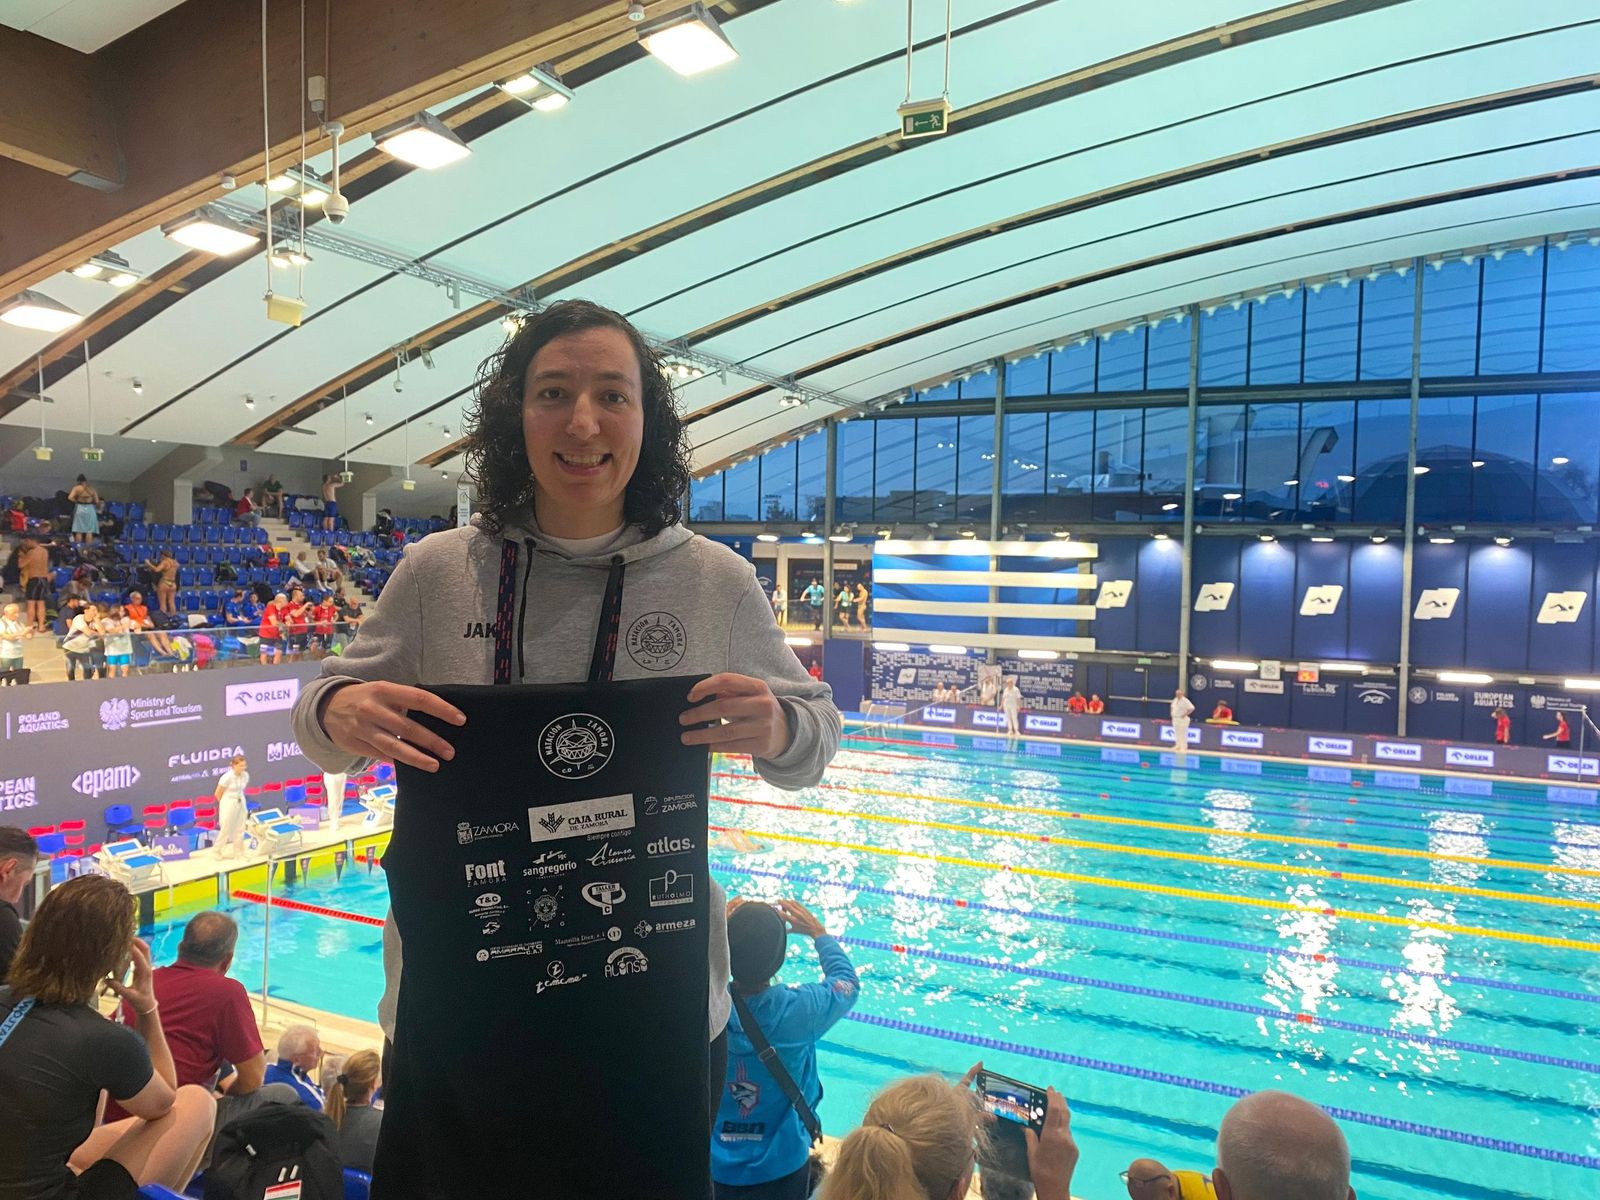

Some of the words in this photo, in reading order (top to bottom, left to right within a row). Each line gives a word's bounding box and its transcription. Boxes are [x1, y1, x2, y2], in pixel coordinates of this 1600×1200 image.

[463, 622, 497, 638] JAK
[130, 697, 164, 708] Ministry
[165, 695, 176, 705] of
[256, 688, 291, 702] ORLEN
[18, 711, 60, 724] POLAND
[130, 707, 153, 720] Sport
[154, 705, 171, 716] and
[172, 703, 202, 715] Tourism
[18, 719, 69, 733] AQUATICS
[1039, 719, 1058, 727] ORLEN
[545, 724, 563, 756] NATACIÓN
[587, 720, 609, 747] ZAMORA
[168, 745, 245, 768] FLUIDRA
[283, 742, 303, 757] Ma
[1393, 748, 1416, 756] ORLEN
[1464, 753, 1489, 761] ORLEN
[661, 801, 698, 813] ZAMORA
[568, 815, 592, 825] CAJA
[594, 809, 628, 822] RURAL
[473, 822, 519, 837] ZAMORA
[580, 820, 608, 829] ZAMORA
[465, 859, 506, 881] Font
[522, 861, 577, 877] sangregorio
[467, 877, 507, 888] ZAMORA
[479, 896, 498, 904] T&C
[655, 919, 696, 931] armeza
[604, 959, 648, 978] ALONSO
[0, 999, 33, 1040] WOJTA
